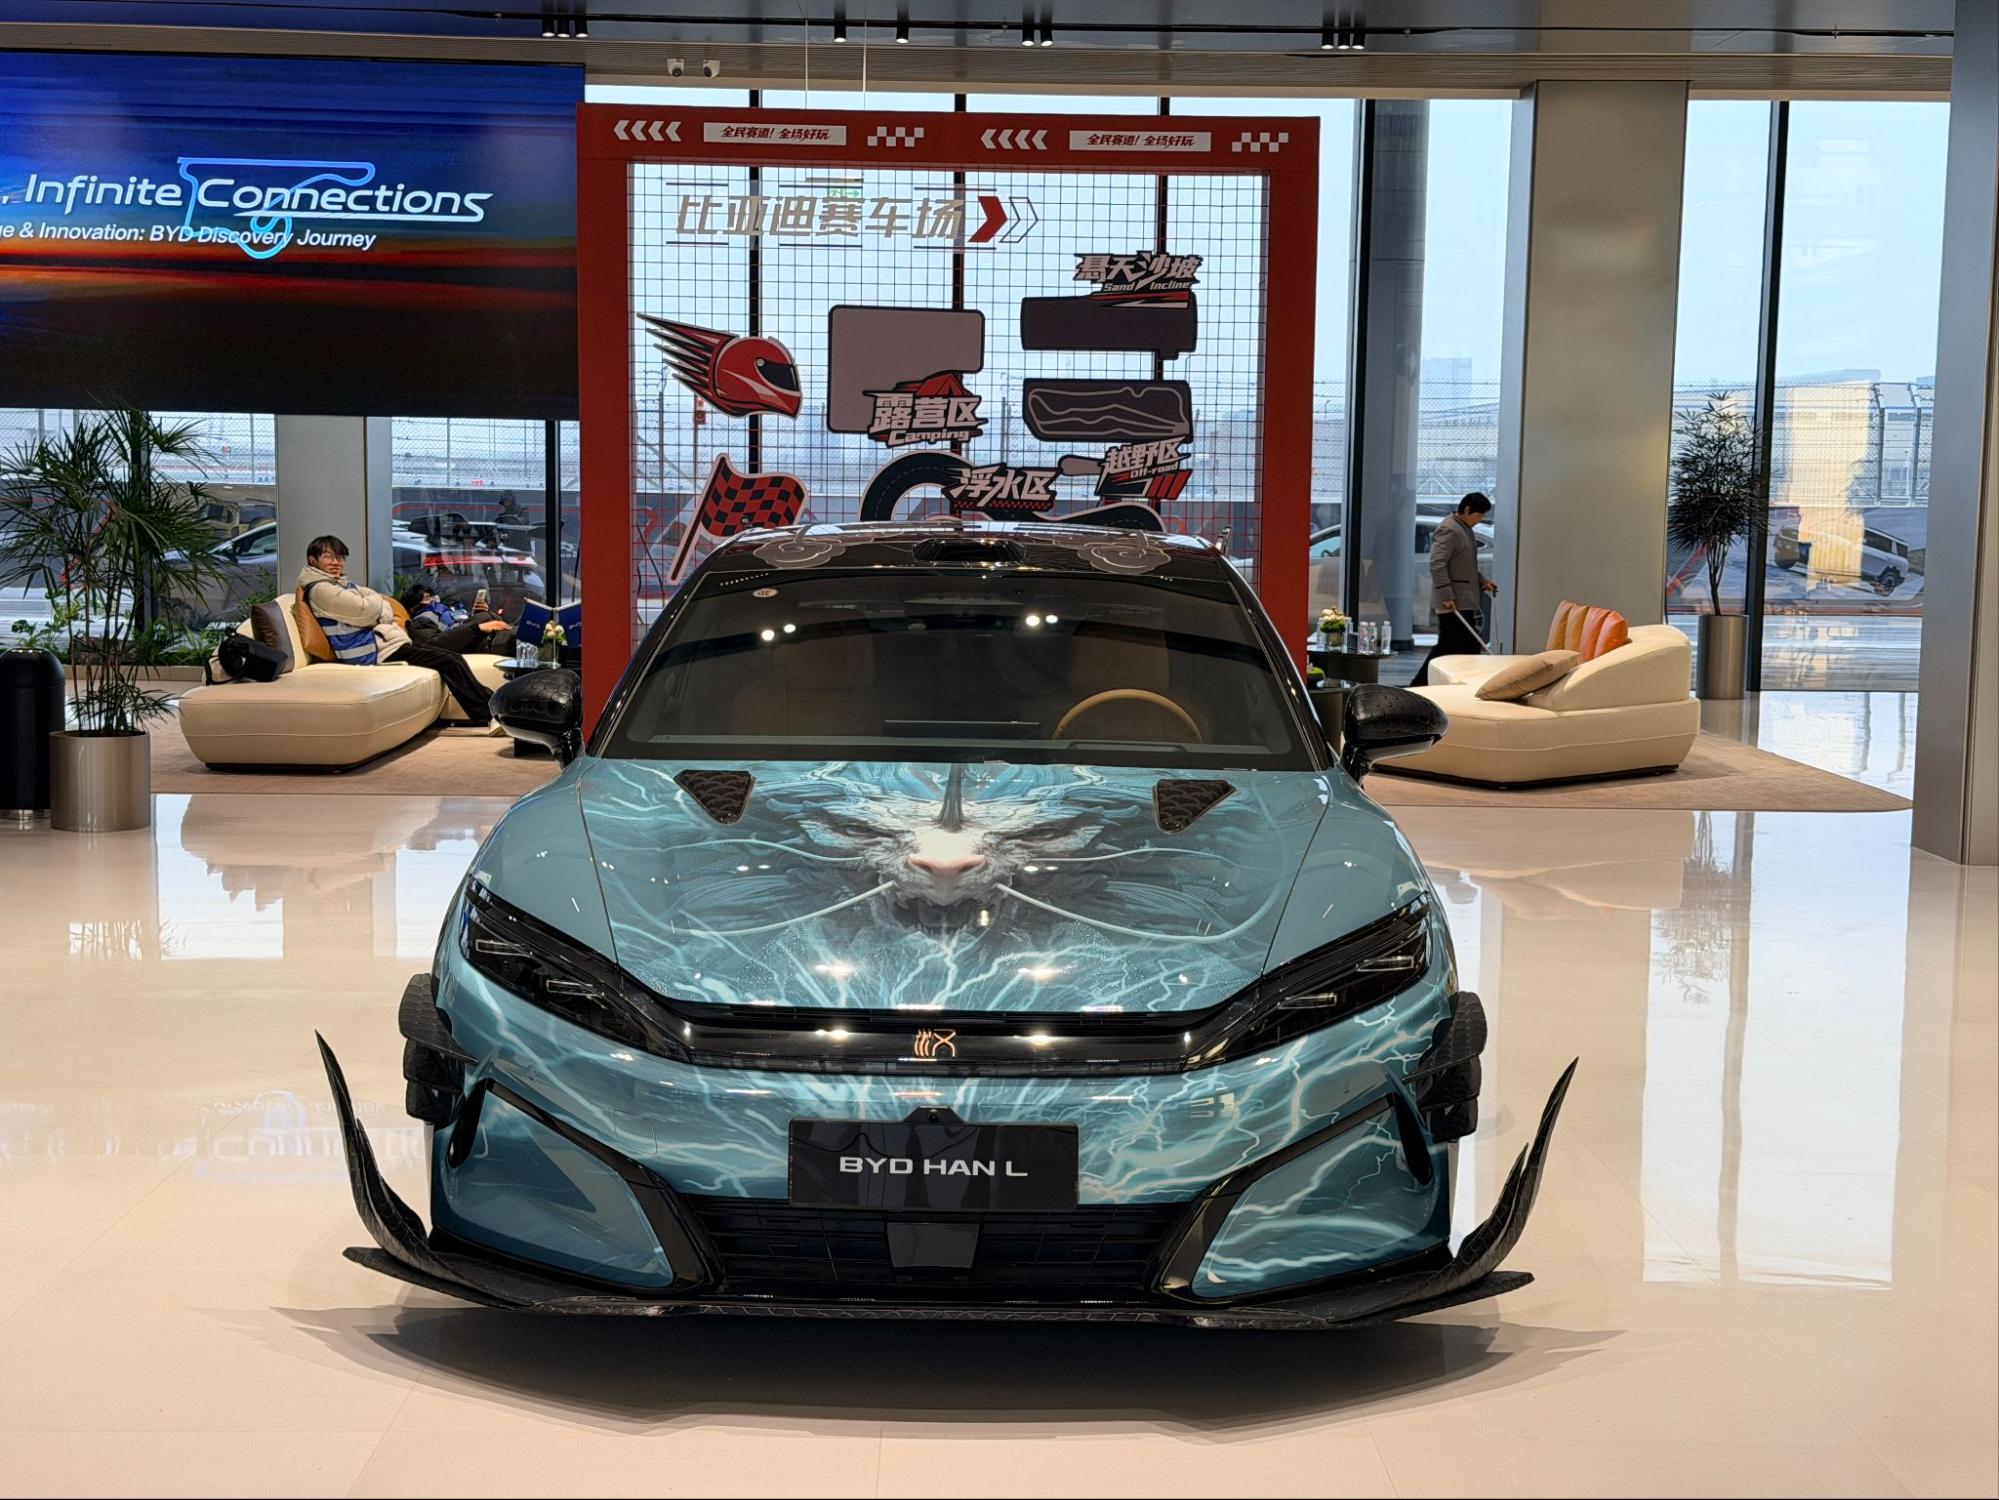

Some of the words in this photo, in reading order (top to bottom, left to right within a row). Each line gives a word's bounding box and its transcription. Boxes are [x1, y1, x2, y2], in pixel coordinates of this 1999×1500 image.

[778, 128, 831, 142] 全场好玩
[1144, 135, 1196, 149] 全场好玩
[25, 174, 183, 215] Infinite
[198, 178, 494, 222] Connections
[676, 194, 965, 239] 比亚迪赛车场
[19, 221, 34, 238] &
[39, 222, 145, 241] Innovation:
[150, 225, 192, 242] BYD
[198, 226, 294, 249] Discovery
[297, 229, 377, 251] Journey
[1103, 282, 1136, 292] Sand
[1150, 281, 1191, 291] Incline
[869, 393, 983, 434] 露营区
[887, 428, 971, 446] Camping
[1098, 436, 1187, 486] 越野区
[948, 465, 1056, 507] 浮水区
[839, 1156, 913, 1174] BYD
[924, 1158, 995, 1176] HAN
[1005, 1160, 1029, 1177] L
